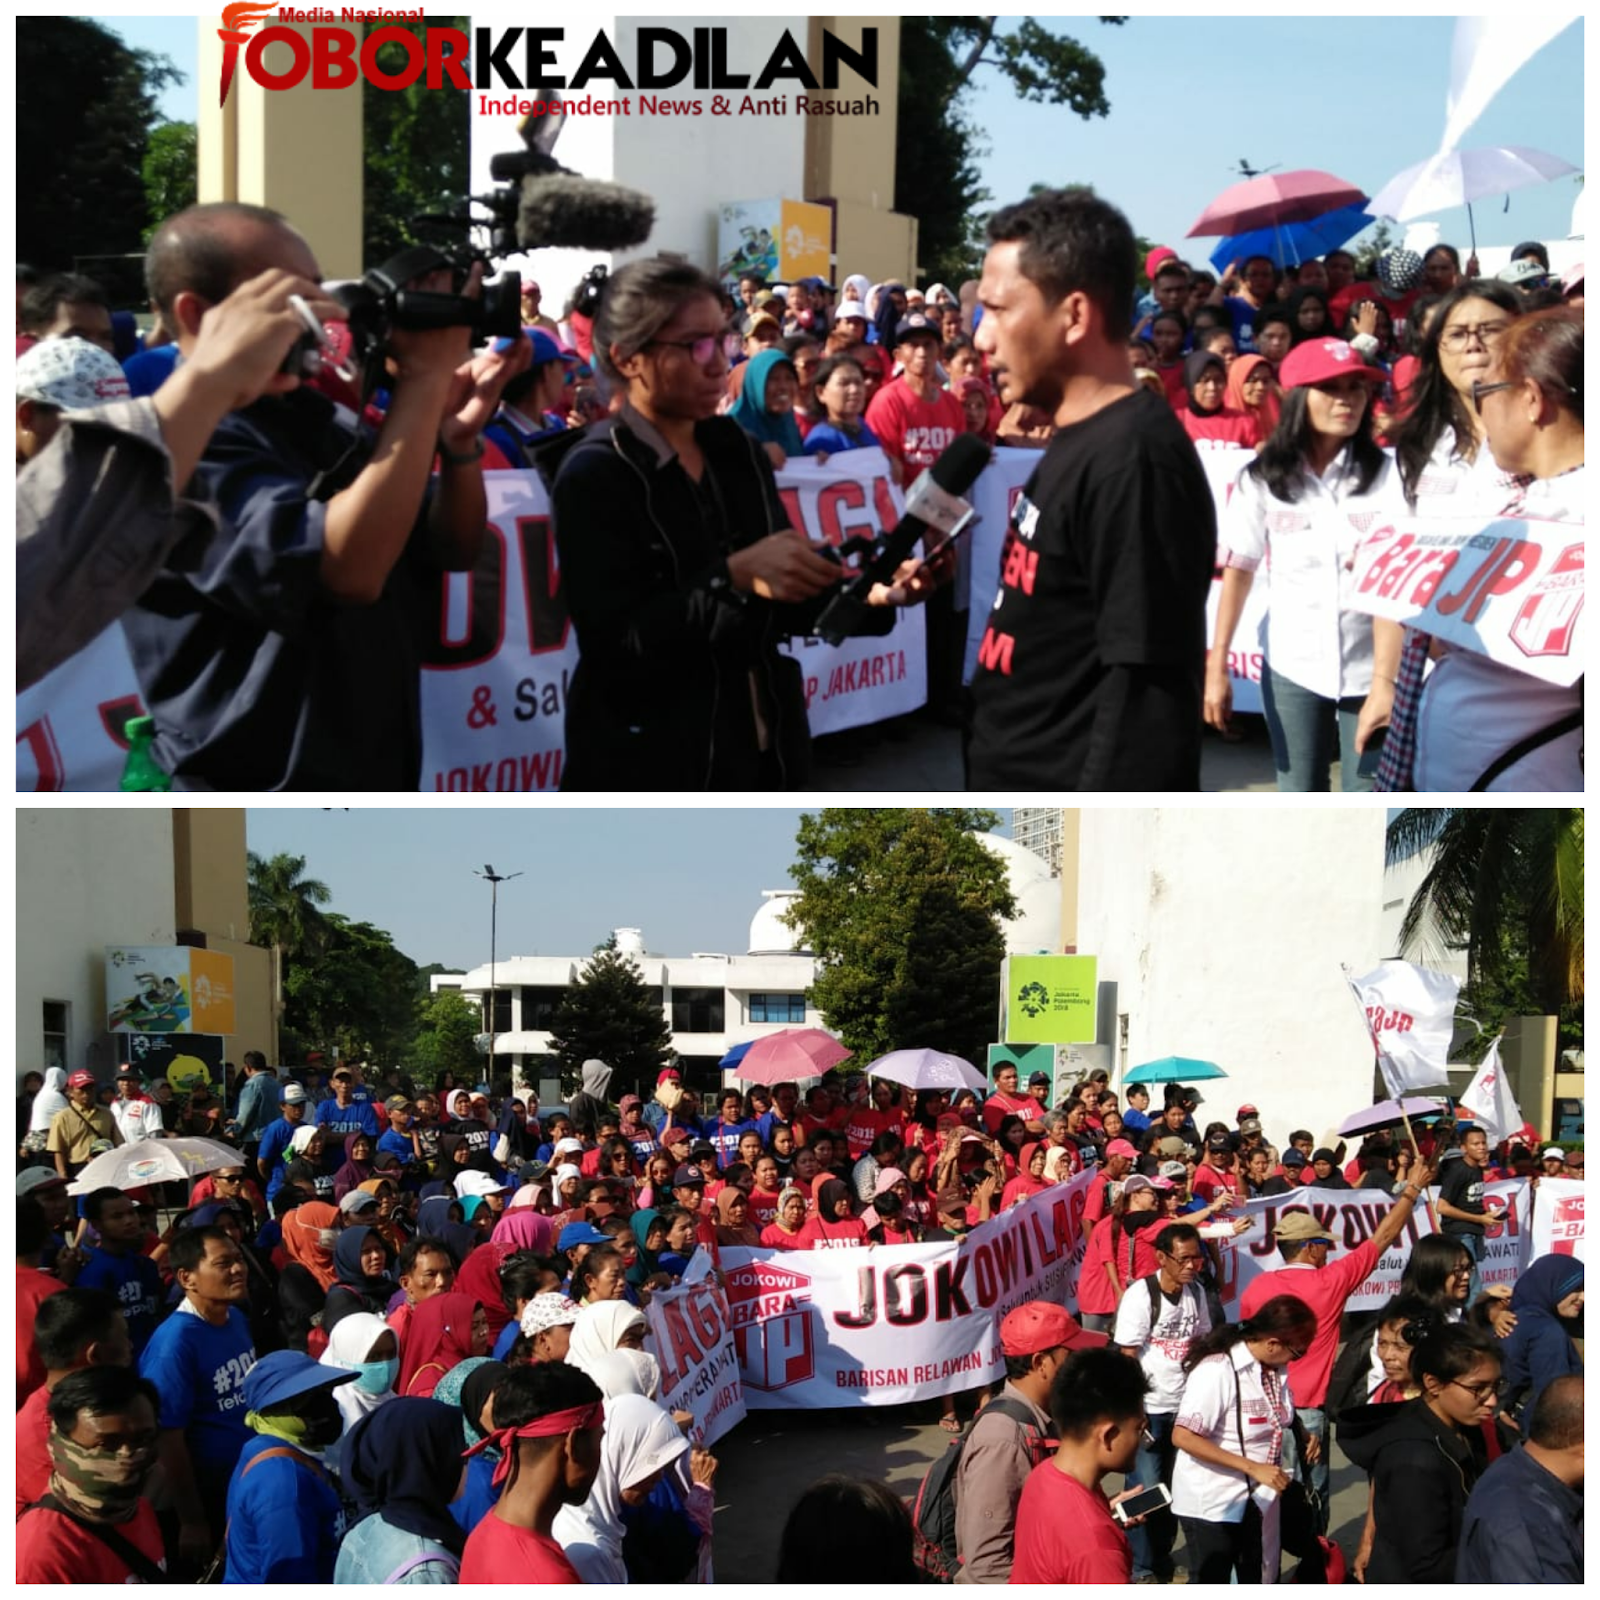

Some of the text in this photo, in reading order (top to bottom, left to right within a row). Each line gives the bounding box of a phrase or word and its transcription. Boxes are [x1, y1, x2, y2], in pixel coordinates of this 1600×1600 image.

[822, 650, 906, 702] JAKARTA
[467, 685, 498, 730] &
[731, 1273, 797, 1288] JOKOWI
[833, 1219, 1034, 1330] JOKOWI
[732, 1293, 799, 1324] BARA
[836, 1366, 909, 1389] BARISAN
[914, 1351, 982, 1384] RELAWAN
